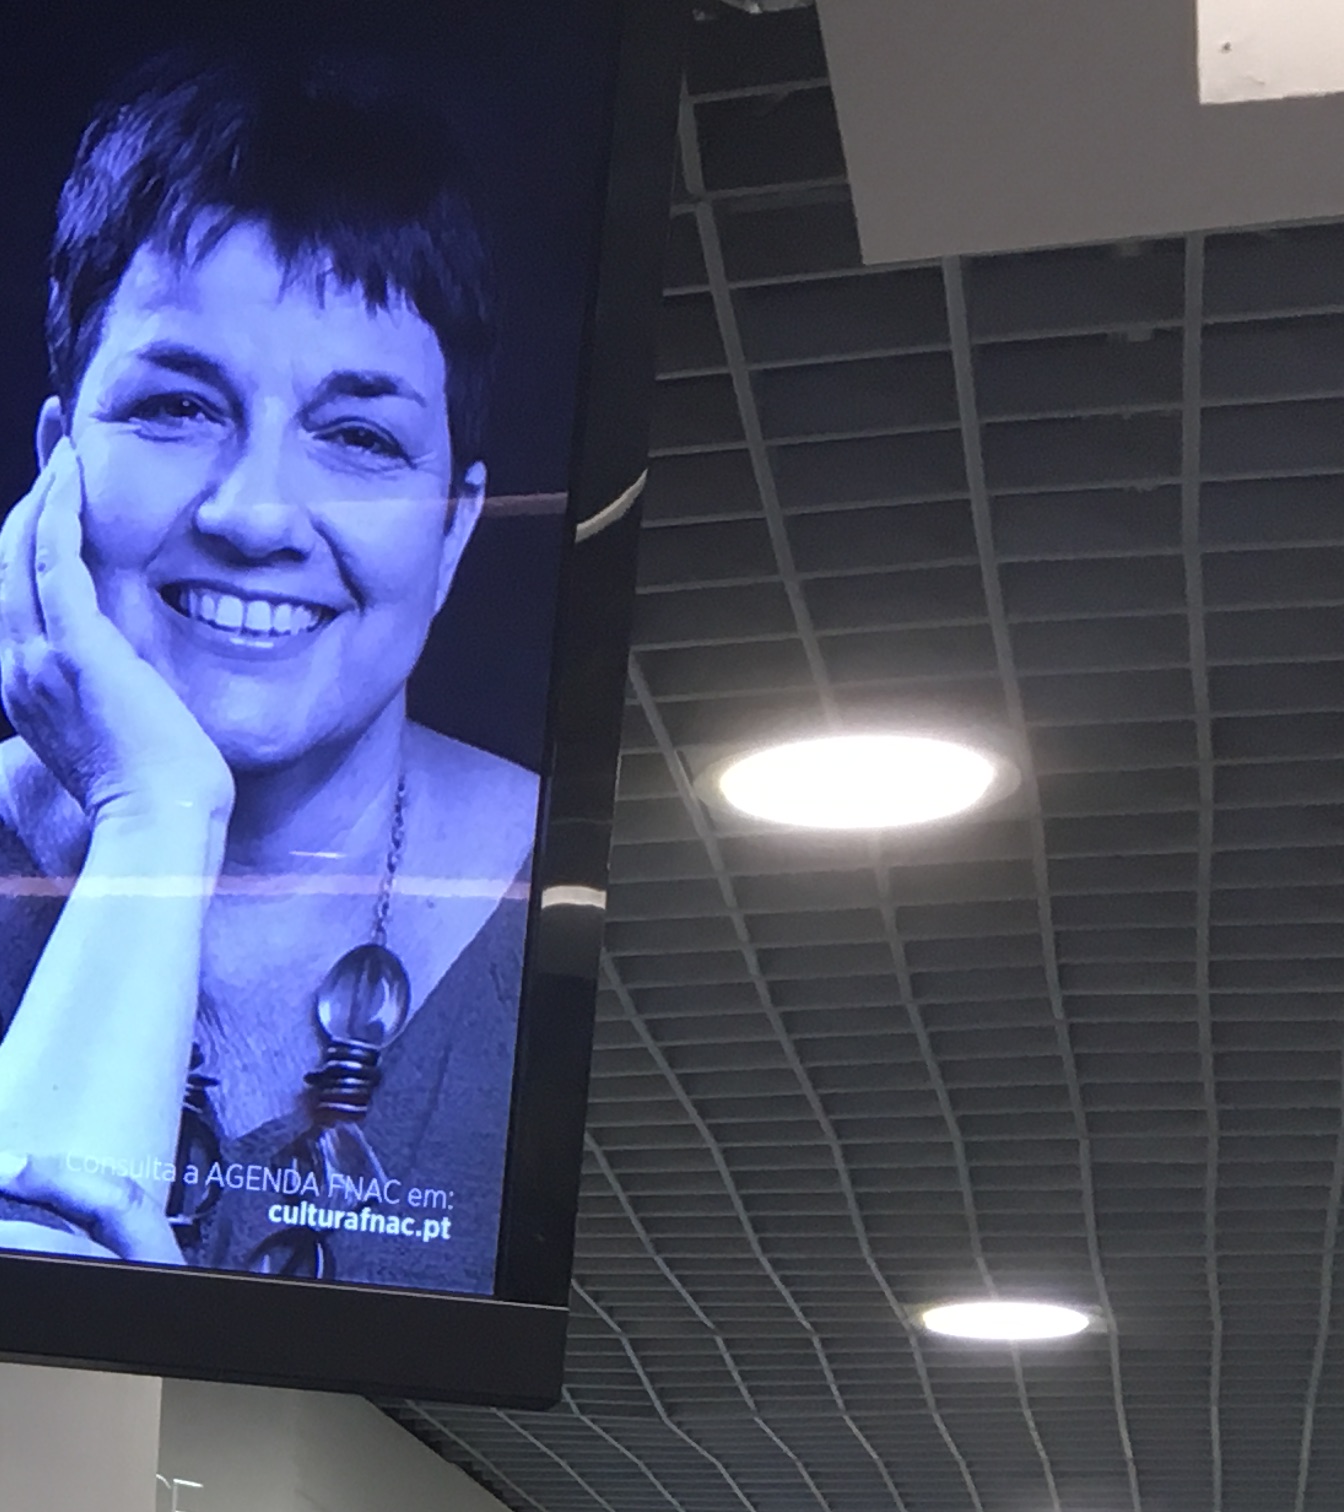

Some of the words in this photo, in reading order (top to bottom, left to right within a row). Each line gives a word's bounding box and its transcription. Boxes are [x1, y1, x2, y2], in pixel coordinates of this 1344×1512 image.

[182, 1162, 200, 1185] a
[204, 1161, 320, 1197] AGENDA
[327, 1173, 402, 1204] FNAC
[407, 1186, 455, 1210] em:
[267, 1200, 452, 1243] culturafnac.pt
